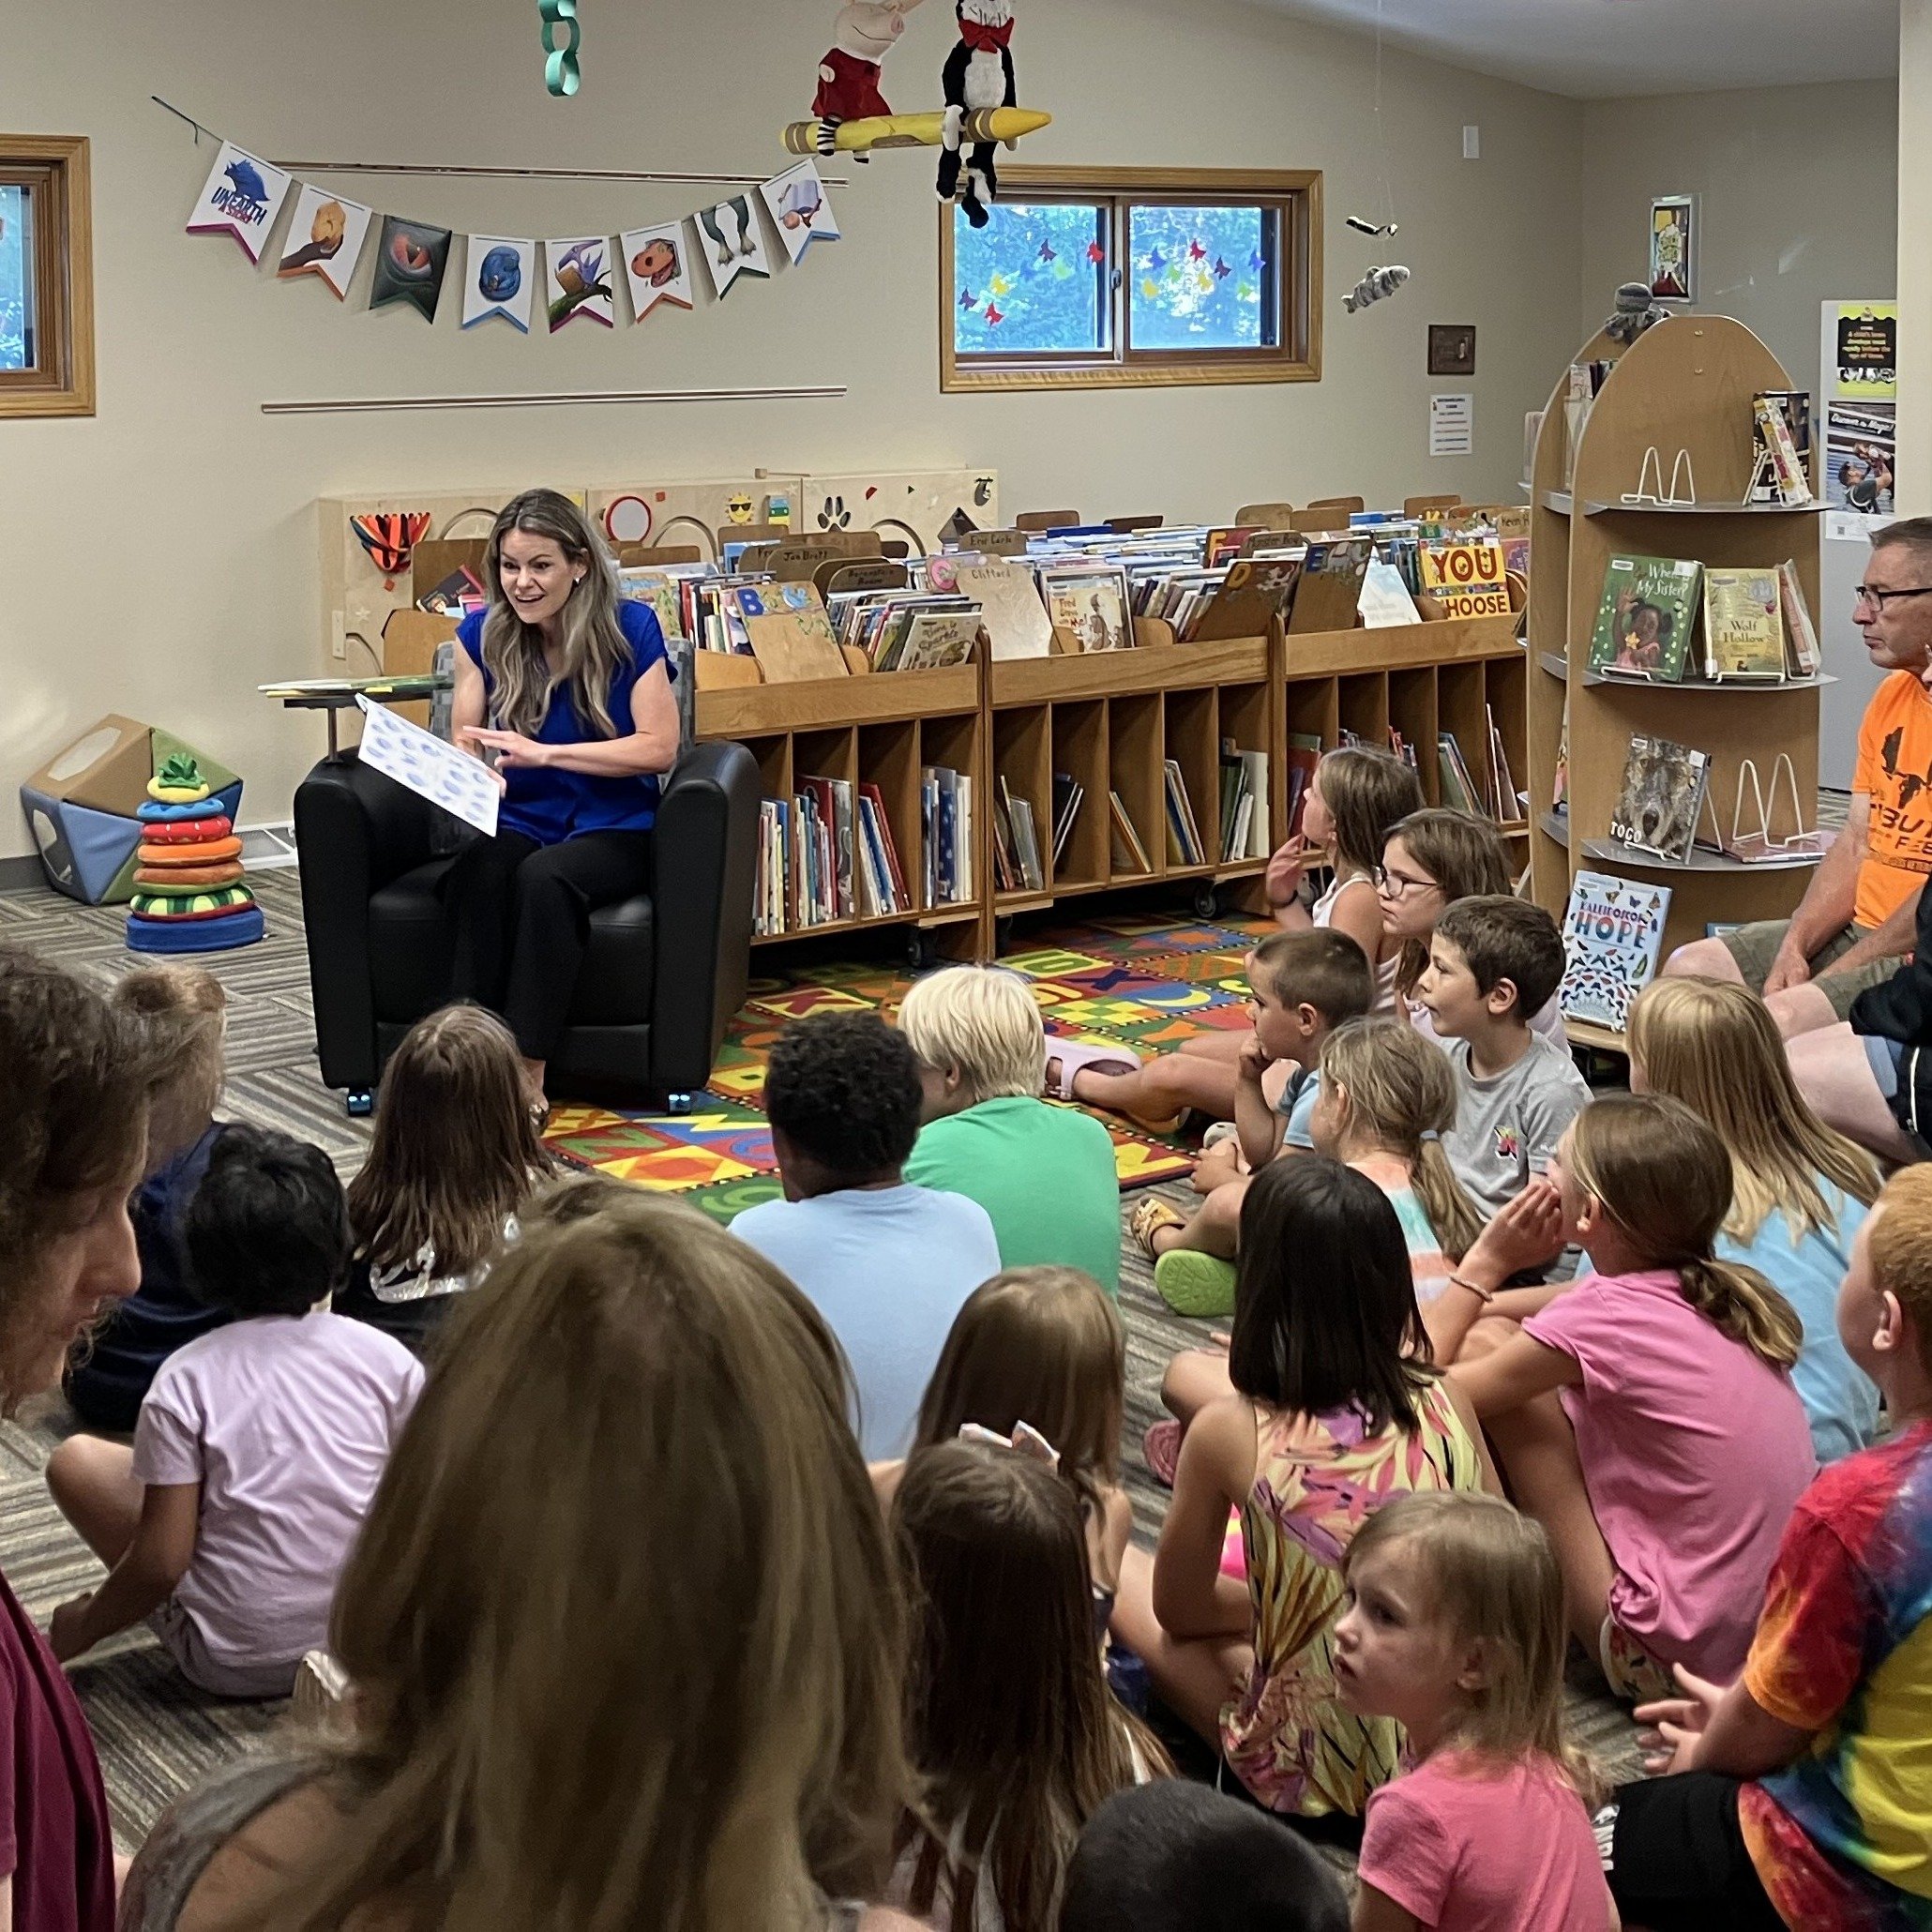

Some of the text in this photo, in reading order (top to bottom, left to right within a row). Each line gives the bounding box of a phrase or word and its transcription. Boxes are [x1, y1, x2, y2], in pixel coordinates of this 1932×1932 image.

[211, 187, 267, 226] UNEARTH
[1429, 548, 1498, 583] YOU
[1445, 595, 1508, 617] HOOSE
[1724, 631, 1764, 643] Hollow
[1730, 620, 1758, 632] Wolf
[1610, 821, 1642, 843] TOGO
[1580, 901, 1643, 923] KALEIDOSCO
[1575, 912, 1648, 949] HOPE
